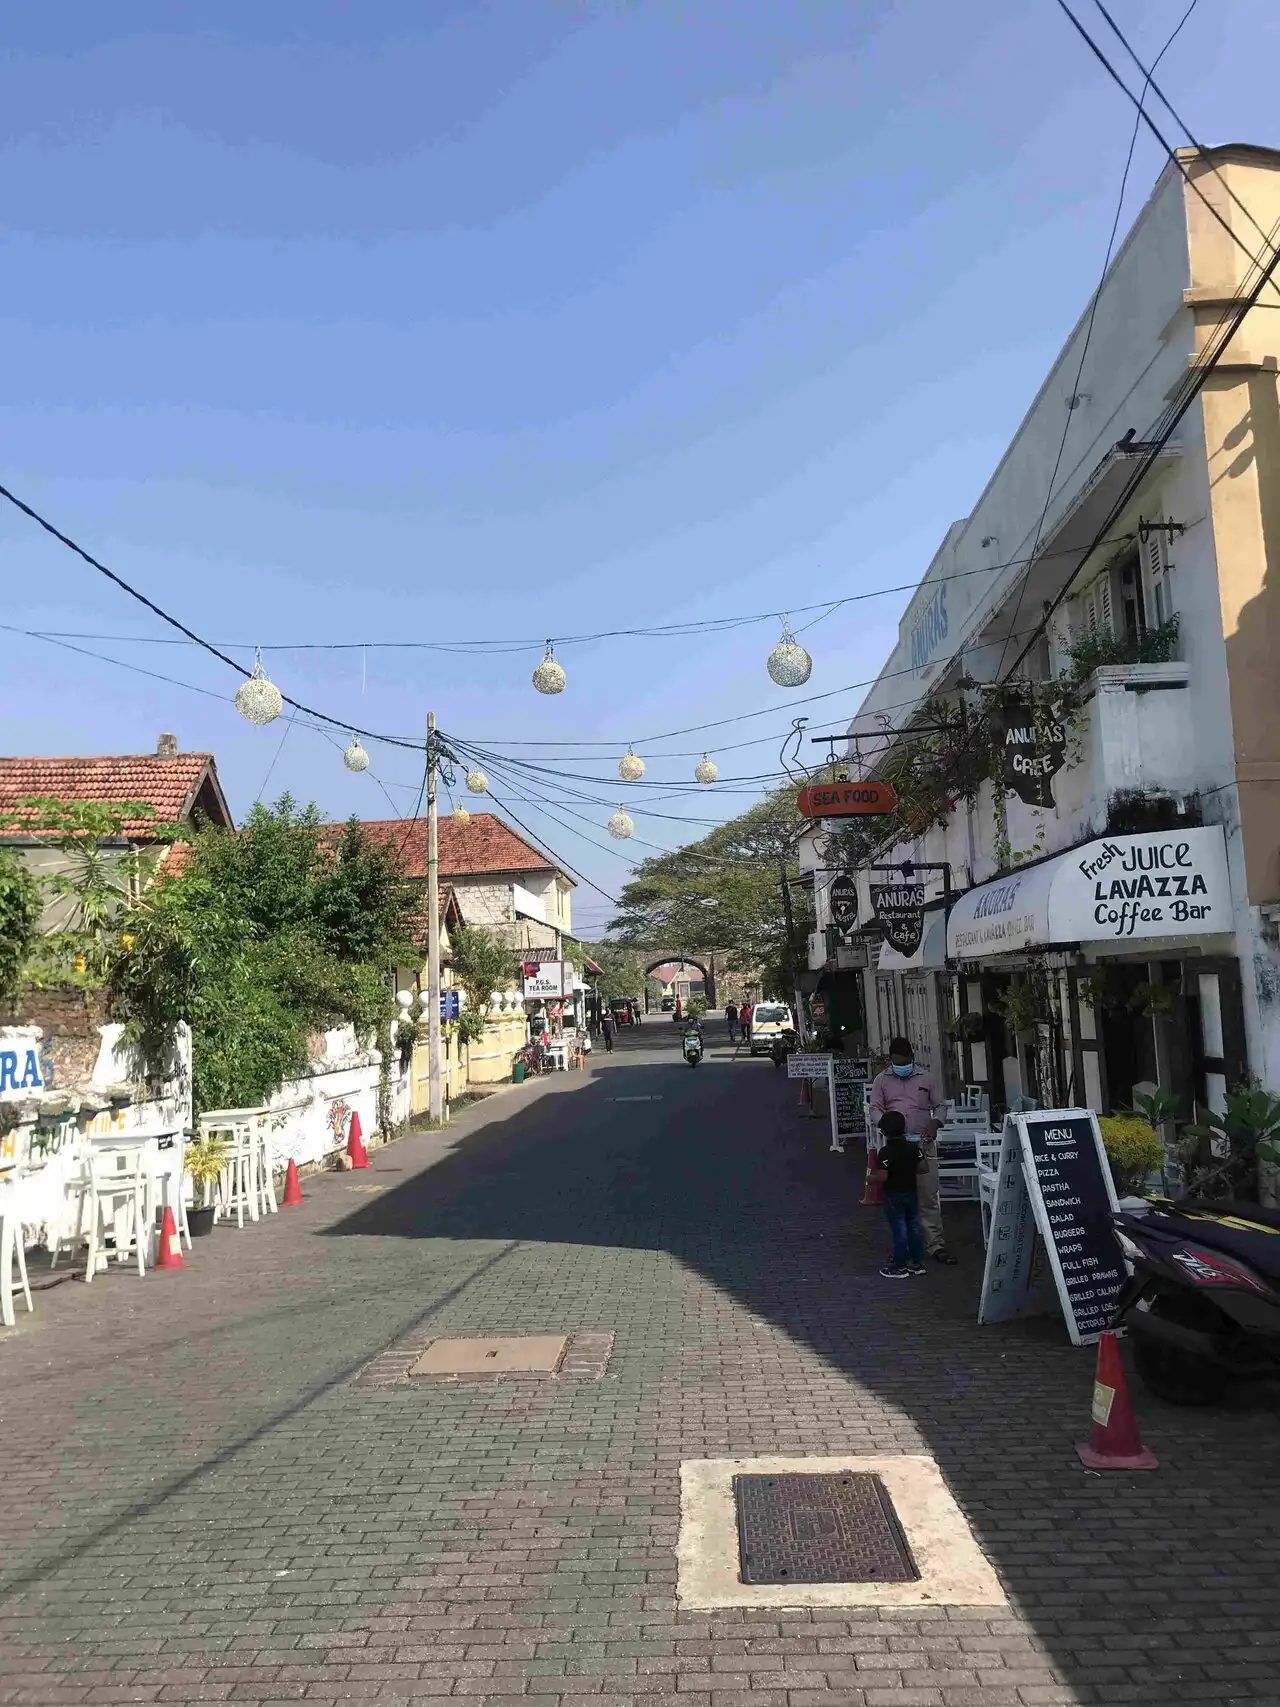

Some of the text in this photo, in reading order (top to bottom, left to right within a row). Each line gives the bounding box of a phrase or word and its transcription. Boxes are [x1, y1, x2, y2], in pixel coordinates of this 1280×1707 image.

[813, 789, 879, 806] SEA FOOD
[1079, 842, 1126, 881] Fresh
[1095, 874, 1208, 901] LAVAZZA
[877, 888, 924, 908] ANURA'S
[880, 911, 921, 920] Restaurant
[1094, 900, 1212, 936] Coffee Bar
[1044, 1128, 1073, 1141] MENU
[1034, 1151, 1079, 1163] RICE & CURRY
[1038, 1168, 1060, 1177] PIZZA
[1042, 1182, 1070, 1193] PASTHA
[1046, 1196, 1081, 1208] SANDWICH
[1050, 1213, 1074, 1224] SALAD
[1054, 1226, 1086, 1239] BURGERS
[1058, 1243, 1082, 1254] WRAPS
[1062, 1257, 1099, 1271] FULL FISH
[1065, 1269, 1119, 1286] GRILLED PRAWNS
[1069, 1290, 1095, 1302] GRILLED
[1073, 1304, 1099, 1317] GRILLED
[1077, 1317, 1106, 1330] OCTOPUS
